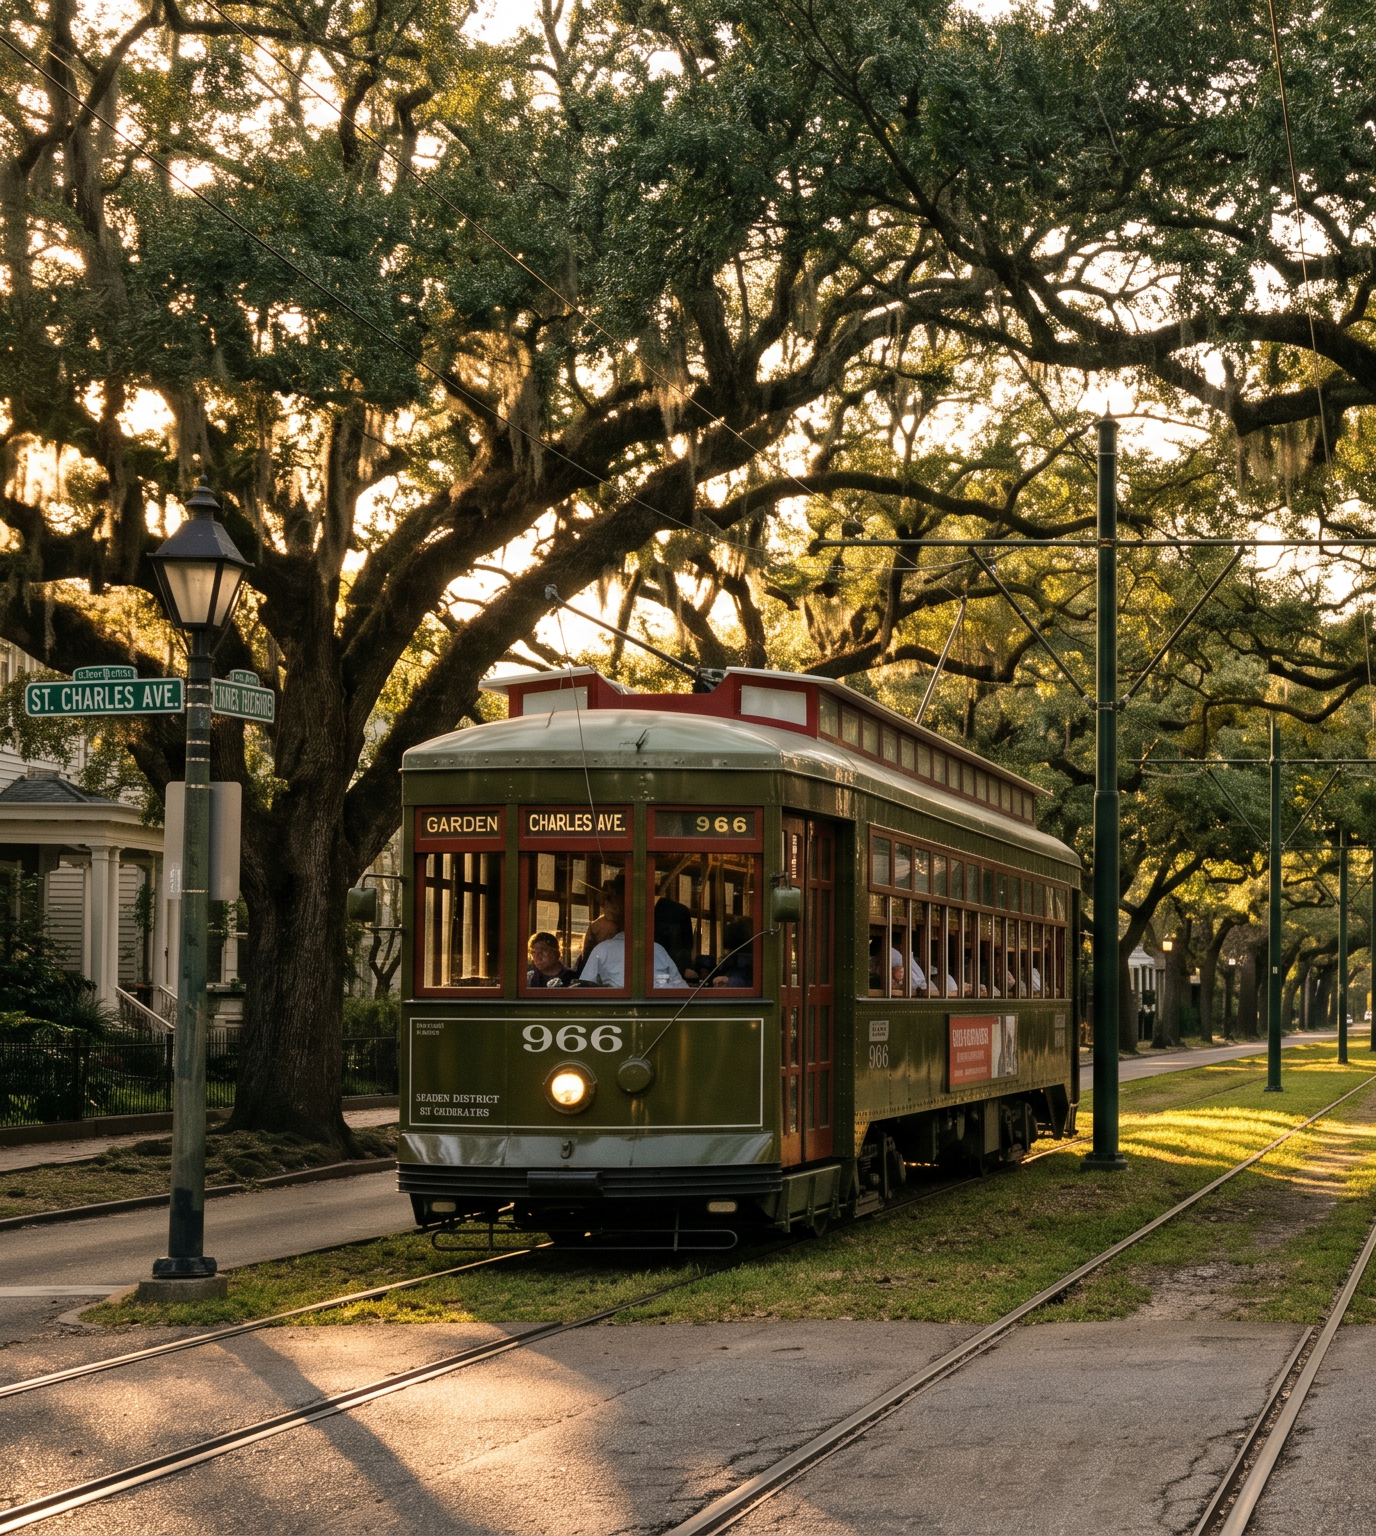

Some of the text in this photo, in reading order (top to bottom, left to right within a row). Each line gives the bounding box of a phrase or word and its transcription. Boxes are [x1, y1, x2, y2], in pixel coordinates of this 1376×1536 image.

[31, 684, 179, 711] ST. CHARLES AVE.
[426, 816, 498, 833] GARDEN
[529, 813, 626, 832] CHARLES AVE.
[696, 815, 747, 833] 966
[522, 1024, 623, 1053] 966
[452, 1094, 500, 1104] DISTRICT
